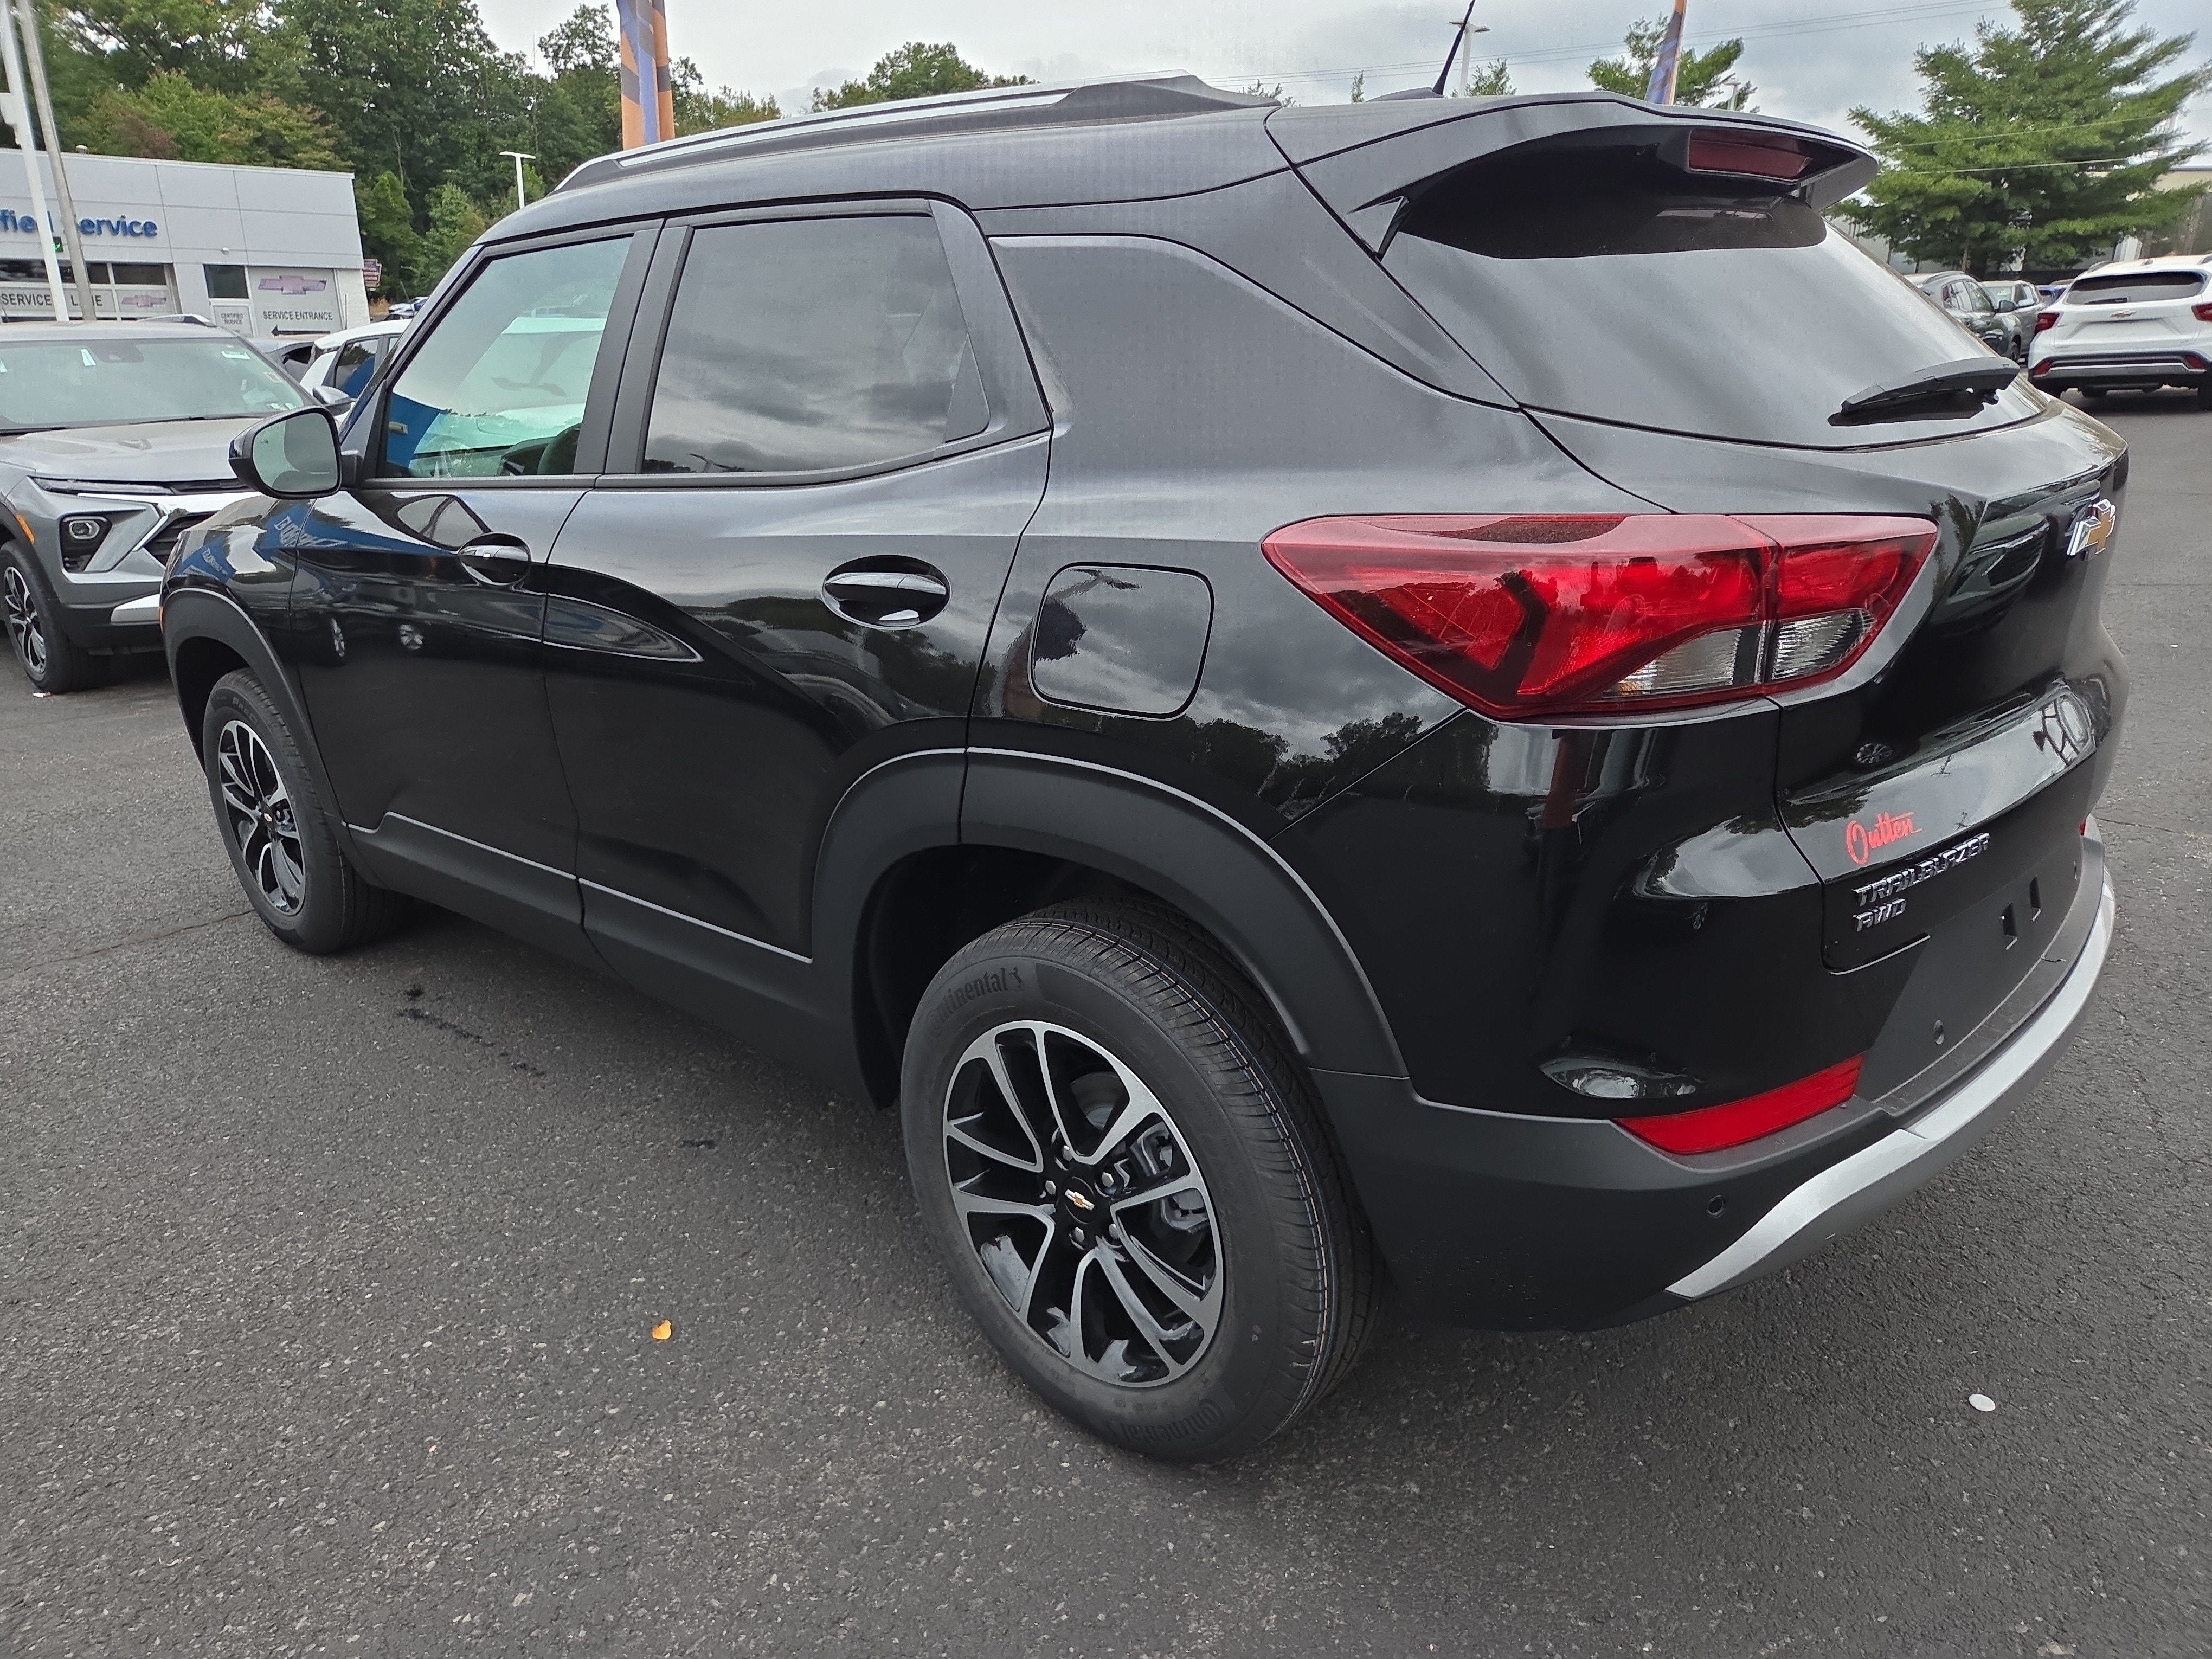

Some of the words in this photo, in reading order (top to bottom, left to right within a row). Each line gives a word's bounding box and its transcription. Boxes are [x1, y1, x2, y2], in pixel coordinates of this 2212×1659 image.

[76, 215, 158, 237] ervice
[1, 293, 53, 306] SERVICE
[70, 294, 104, 307] LE
[263, 310, 293, 320] SERVICE
[295, 311, 332, 321] ENTRANCE
[1846, 812, 1923, 864] Outten
[1852, 832, 1990, 906] TRAILBLAZER
[1853, 898, 1906, 932] AWD
